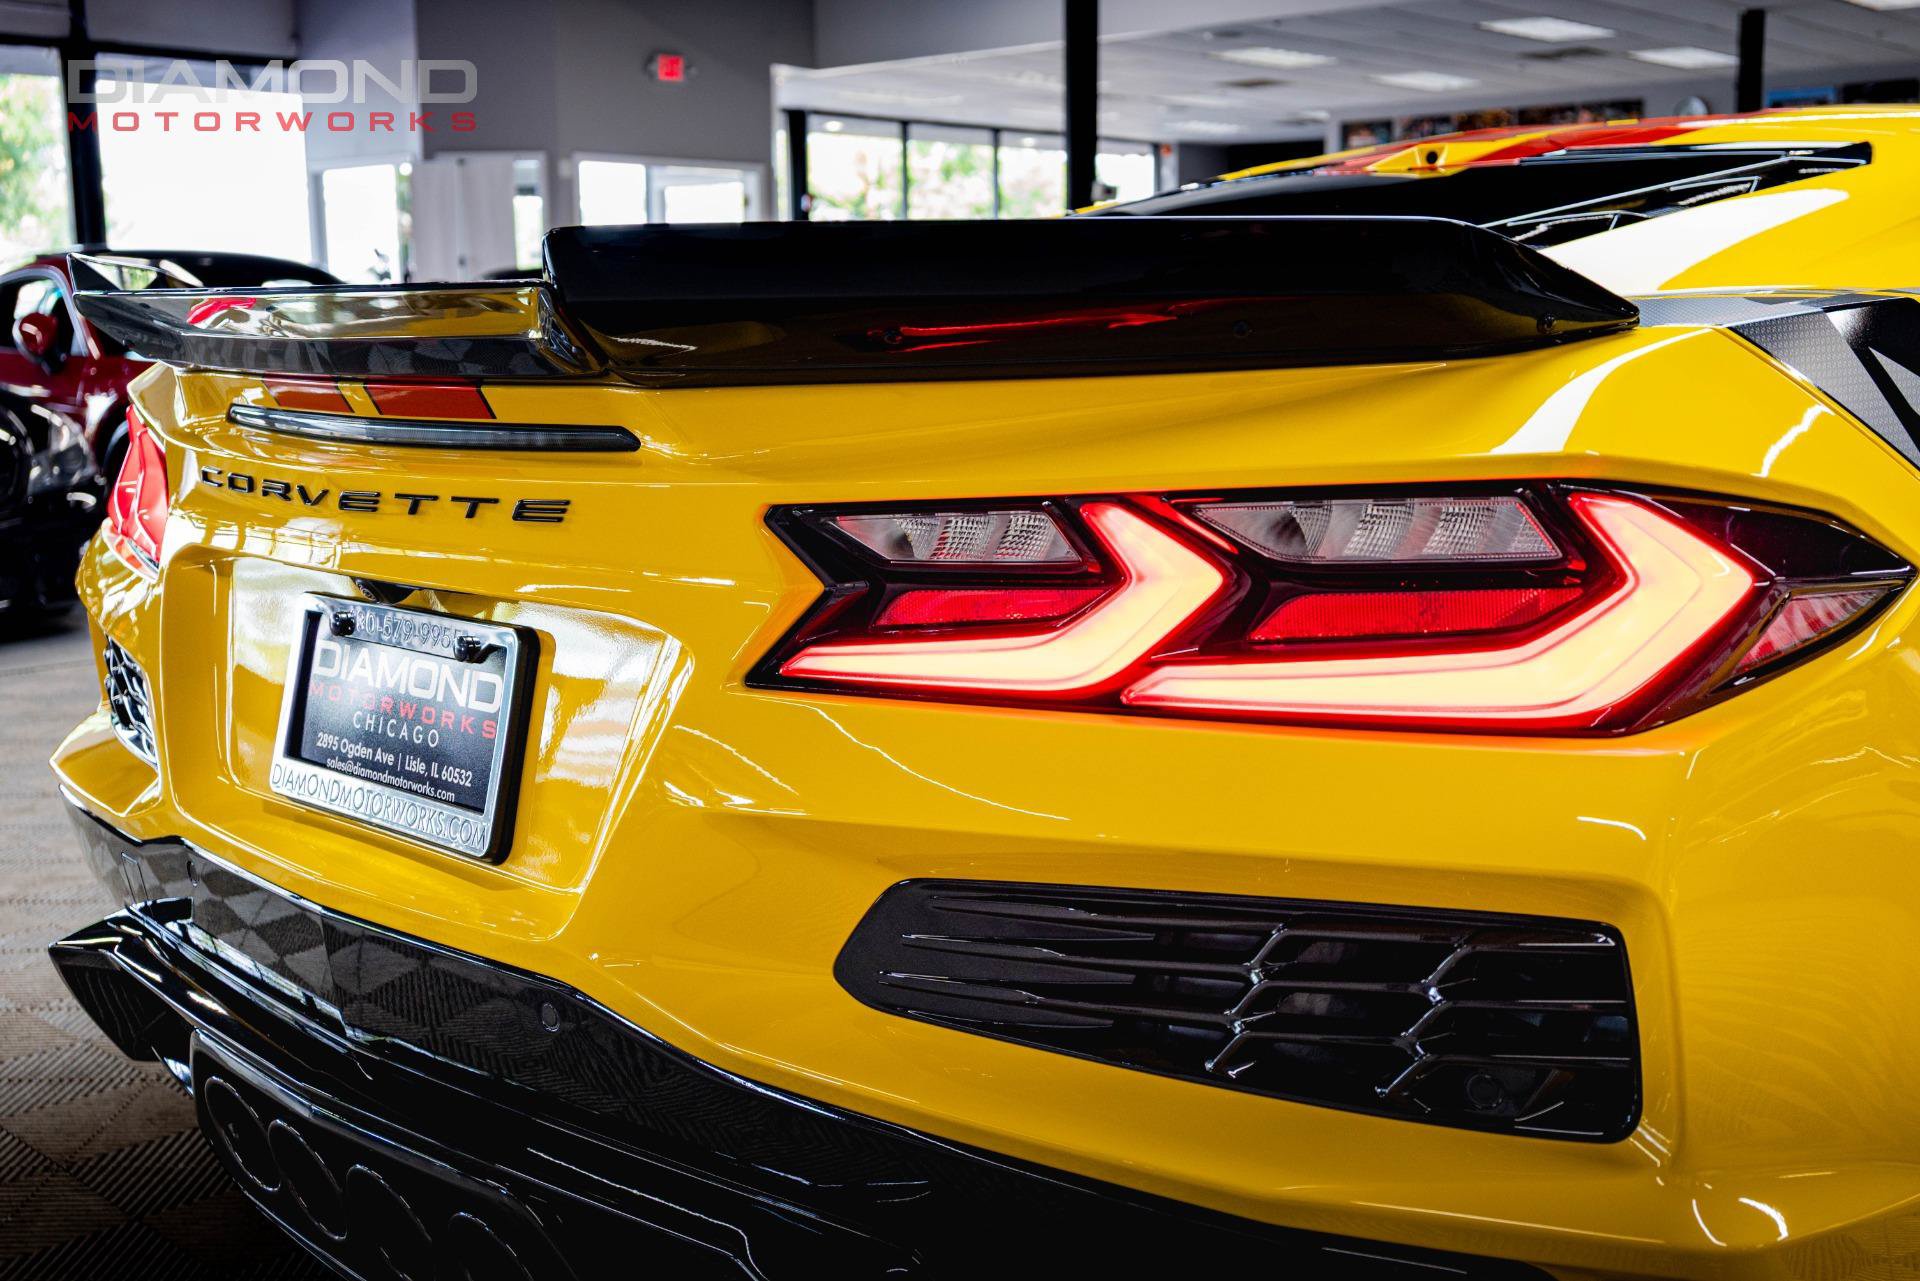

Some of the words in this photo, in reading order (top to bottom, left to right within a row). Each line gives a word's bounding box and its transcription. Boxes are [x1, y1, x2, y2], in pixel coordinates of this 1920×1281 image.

[200, 465, 571, 522] CORVETTE
[312, 639, 503, 714] DIAMOND
[309, 681, 498, 740] MOTORWORKS
[352, 710, 439, 748] CHICAGO
[316, 731, 339, 751] 2895
[340, 738, 373, 758] Ogden
[374, 747, 395, 766] Ave
[404, 754, 428, 777] Lisle,
[430, 761, 439, 778] IL
[441, 765, 473, 788] 60532
[326, 756, 455, 802] sales@diamondmotorworks.com
[271, 763, 487, 850] DIAMONDMOTORWORKS.COM
